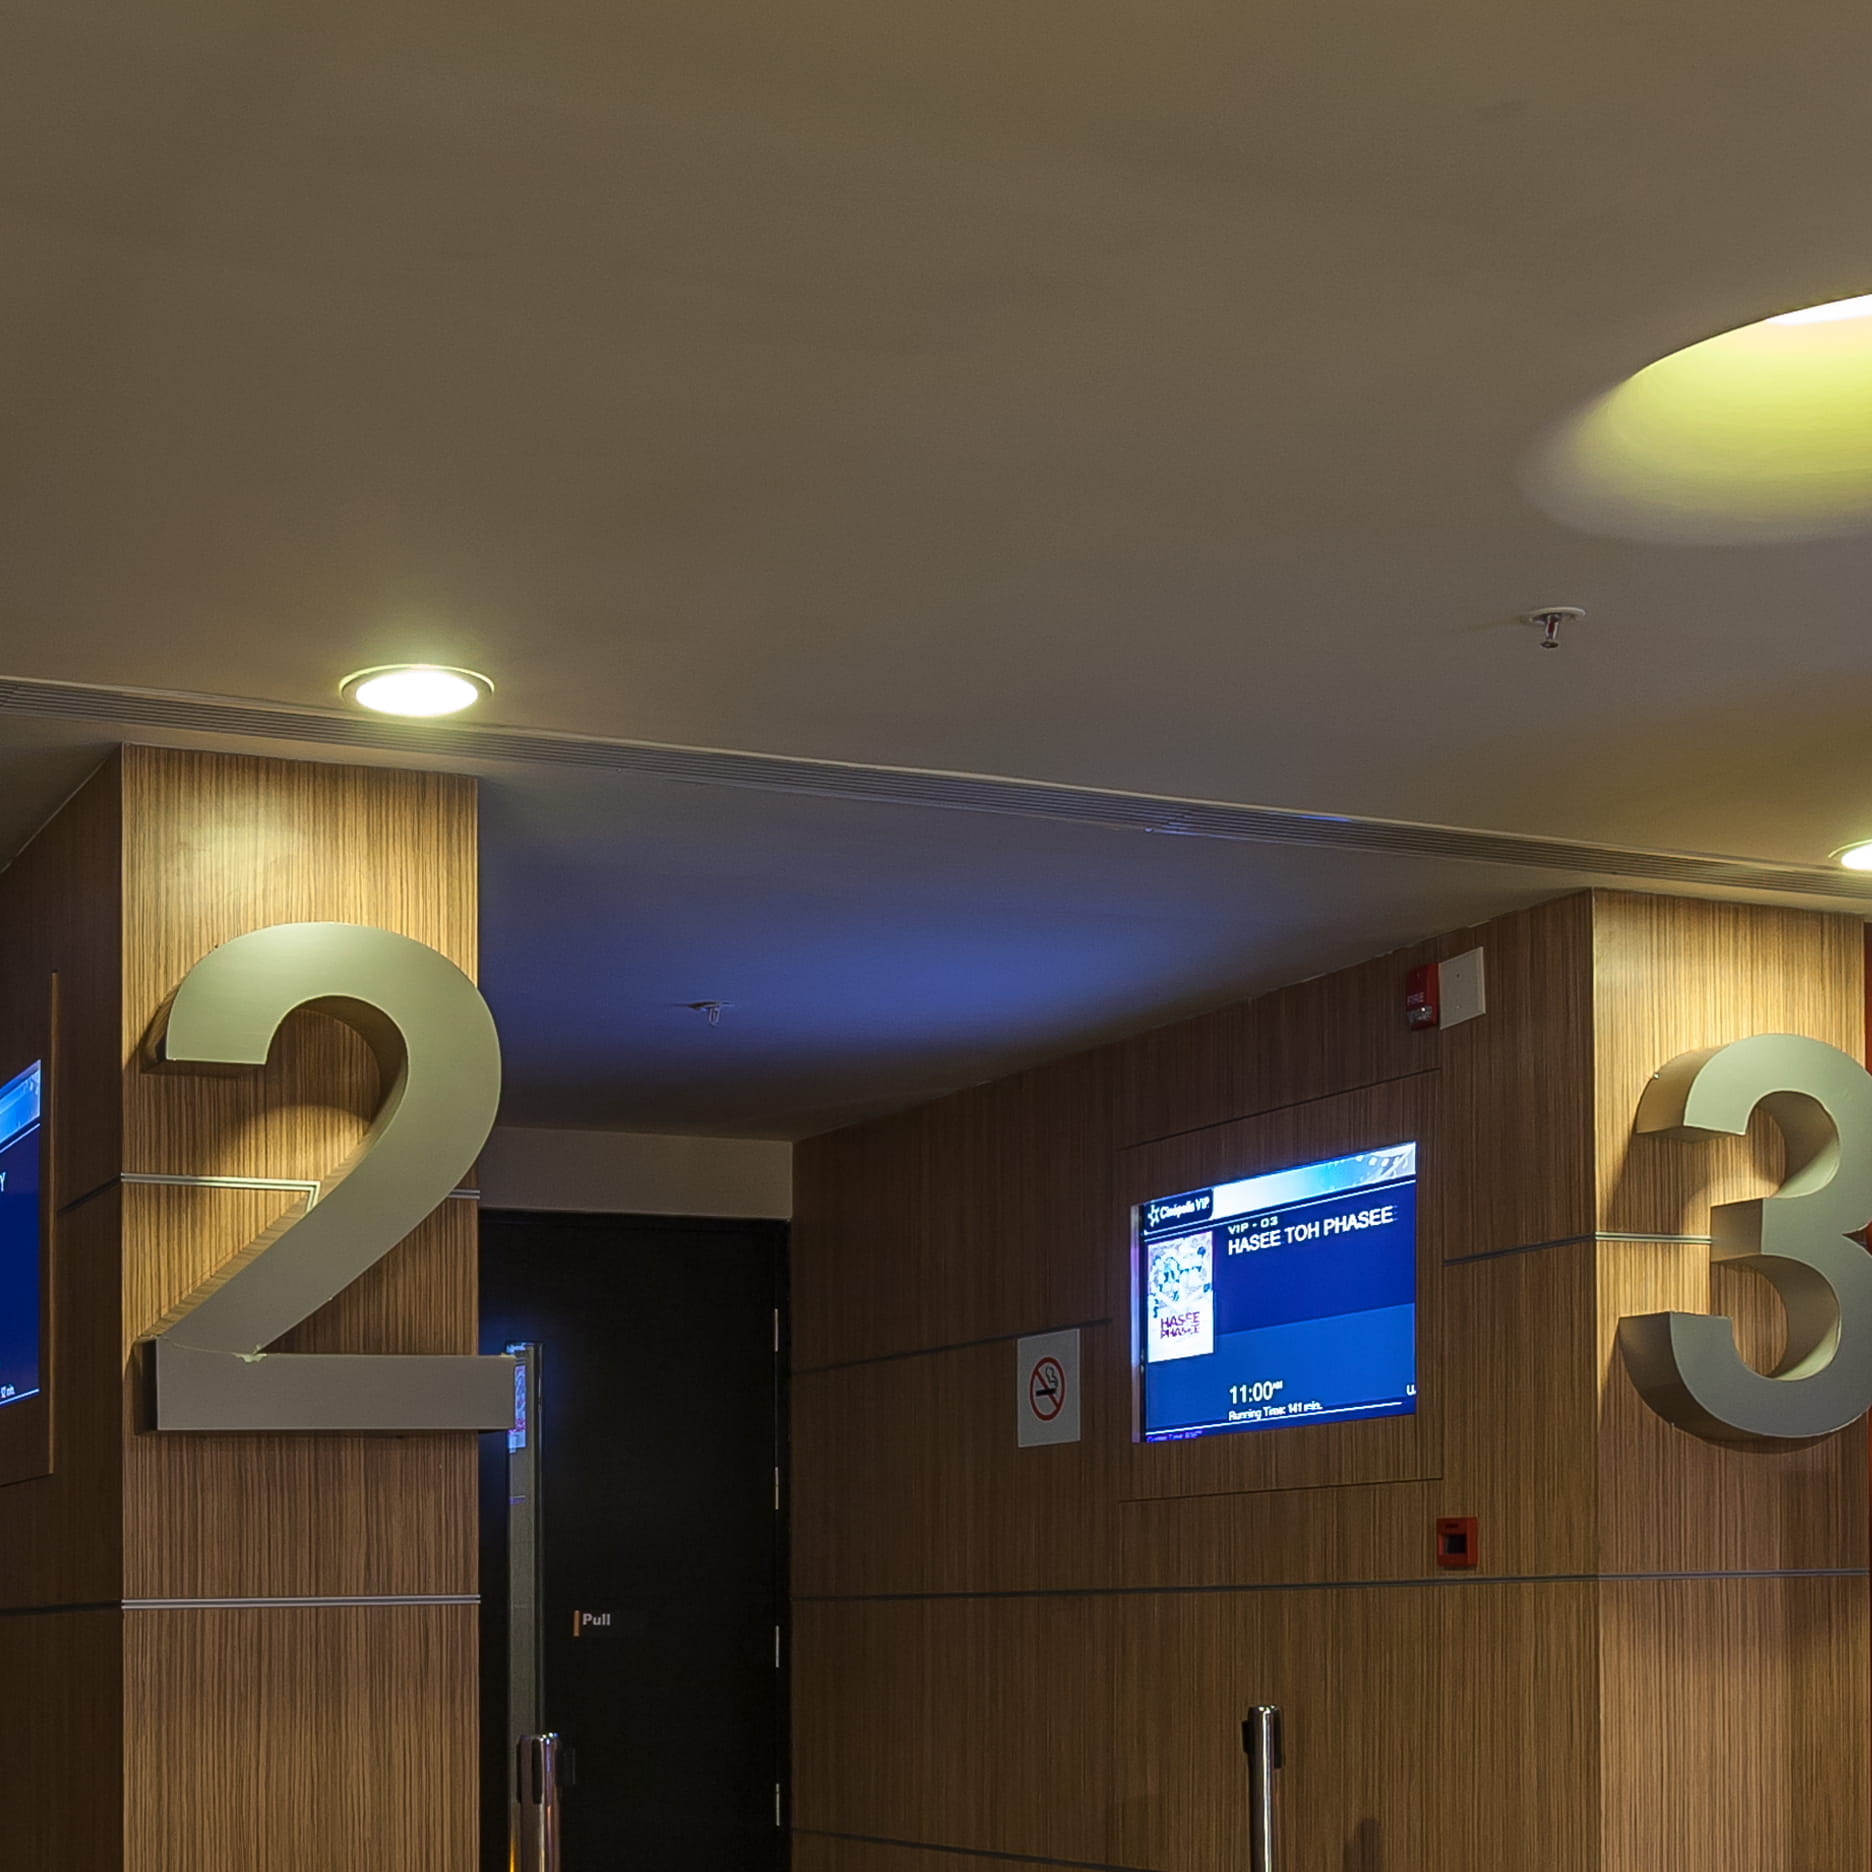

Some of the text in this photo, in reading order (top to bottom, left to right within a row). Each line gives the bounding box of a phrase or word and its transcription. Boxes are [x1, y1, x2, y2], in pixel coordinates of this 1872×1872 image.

[150, 921, 516, 1431] 2
[1228, 1222, 1249, 1235] VIP
[1260, 1216, 1279, 1228] 03
[1228, 1206, 1394, 1255] HASEE TOH PHASEE
[582, 1613, 611, 1626] Pull
